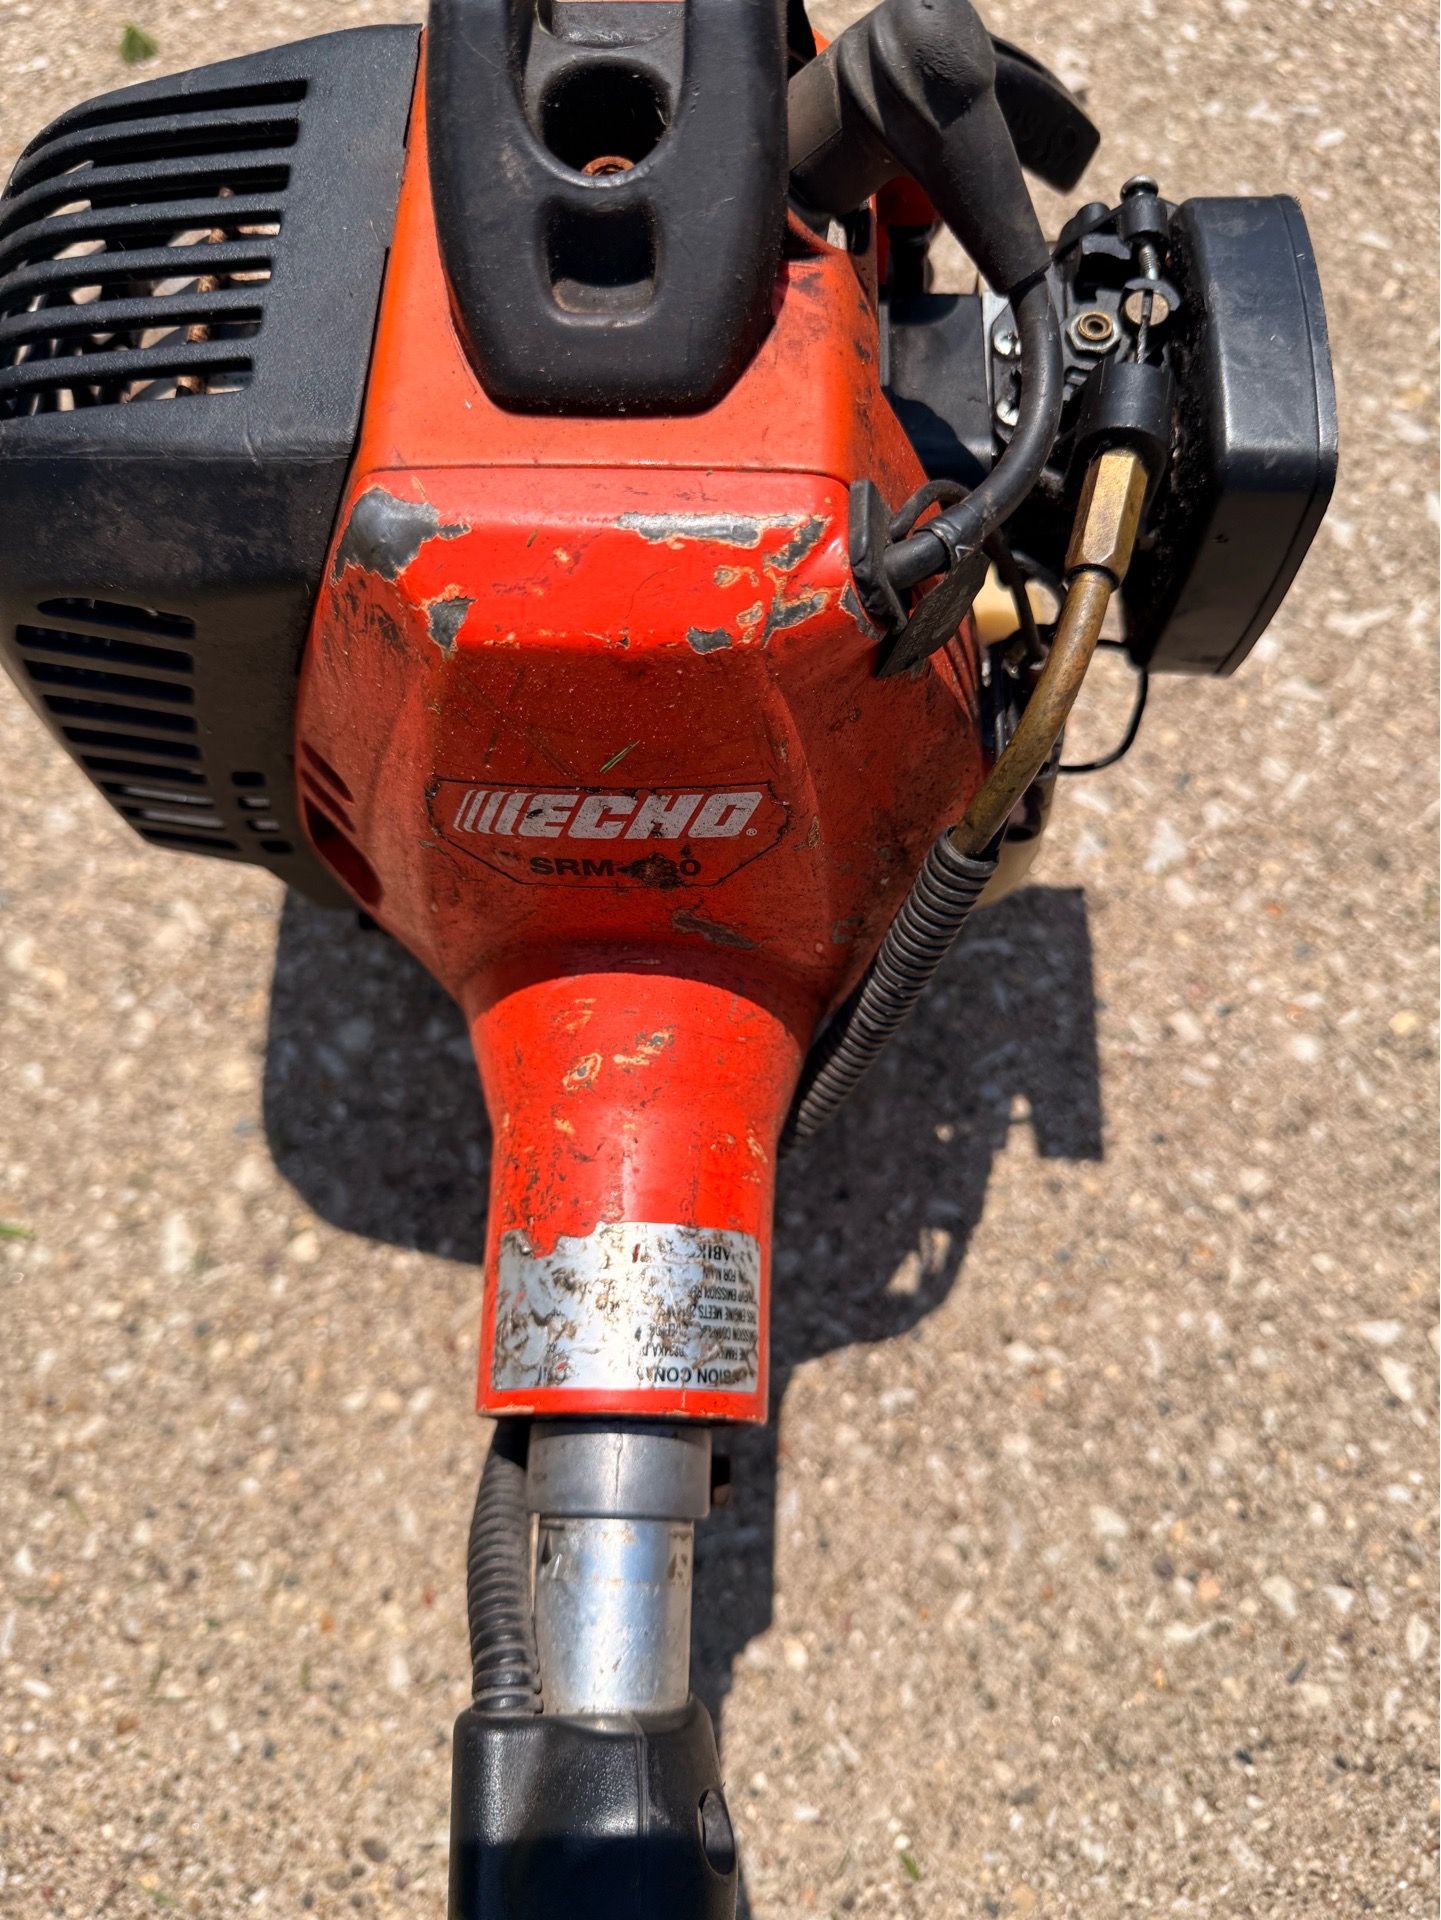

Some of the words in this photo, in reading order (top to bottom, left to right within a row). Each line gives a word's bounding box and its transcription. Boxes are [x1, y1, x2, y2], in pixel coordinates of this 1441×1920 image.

[518, 791, 763, 839] ECHO
[529, 856, 701, 877] SRM-0
[698, 1305, 722, 1320] MEETS
